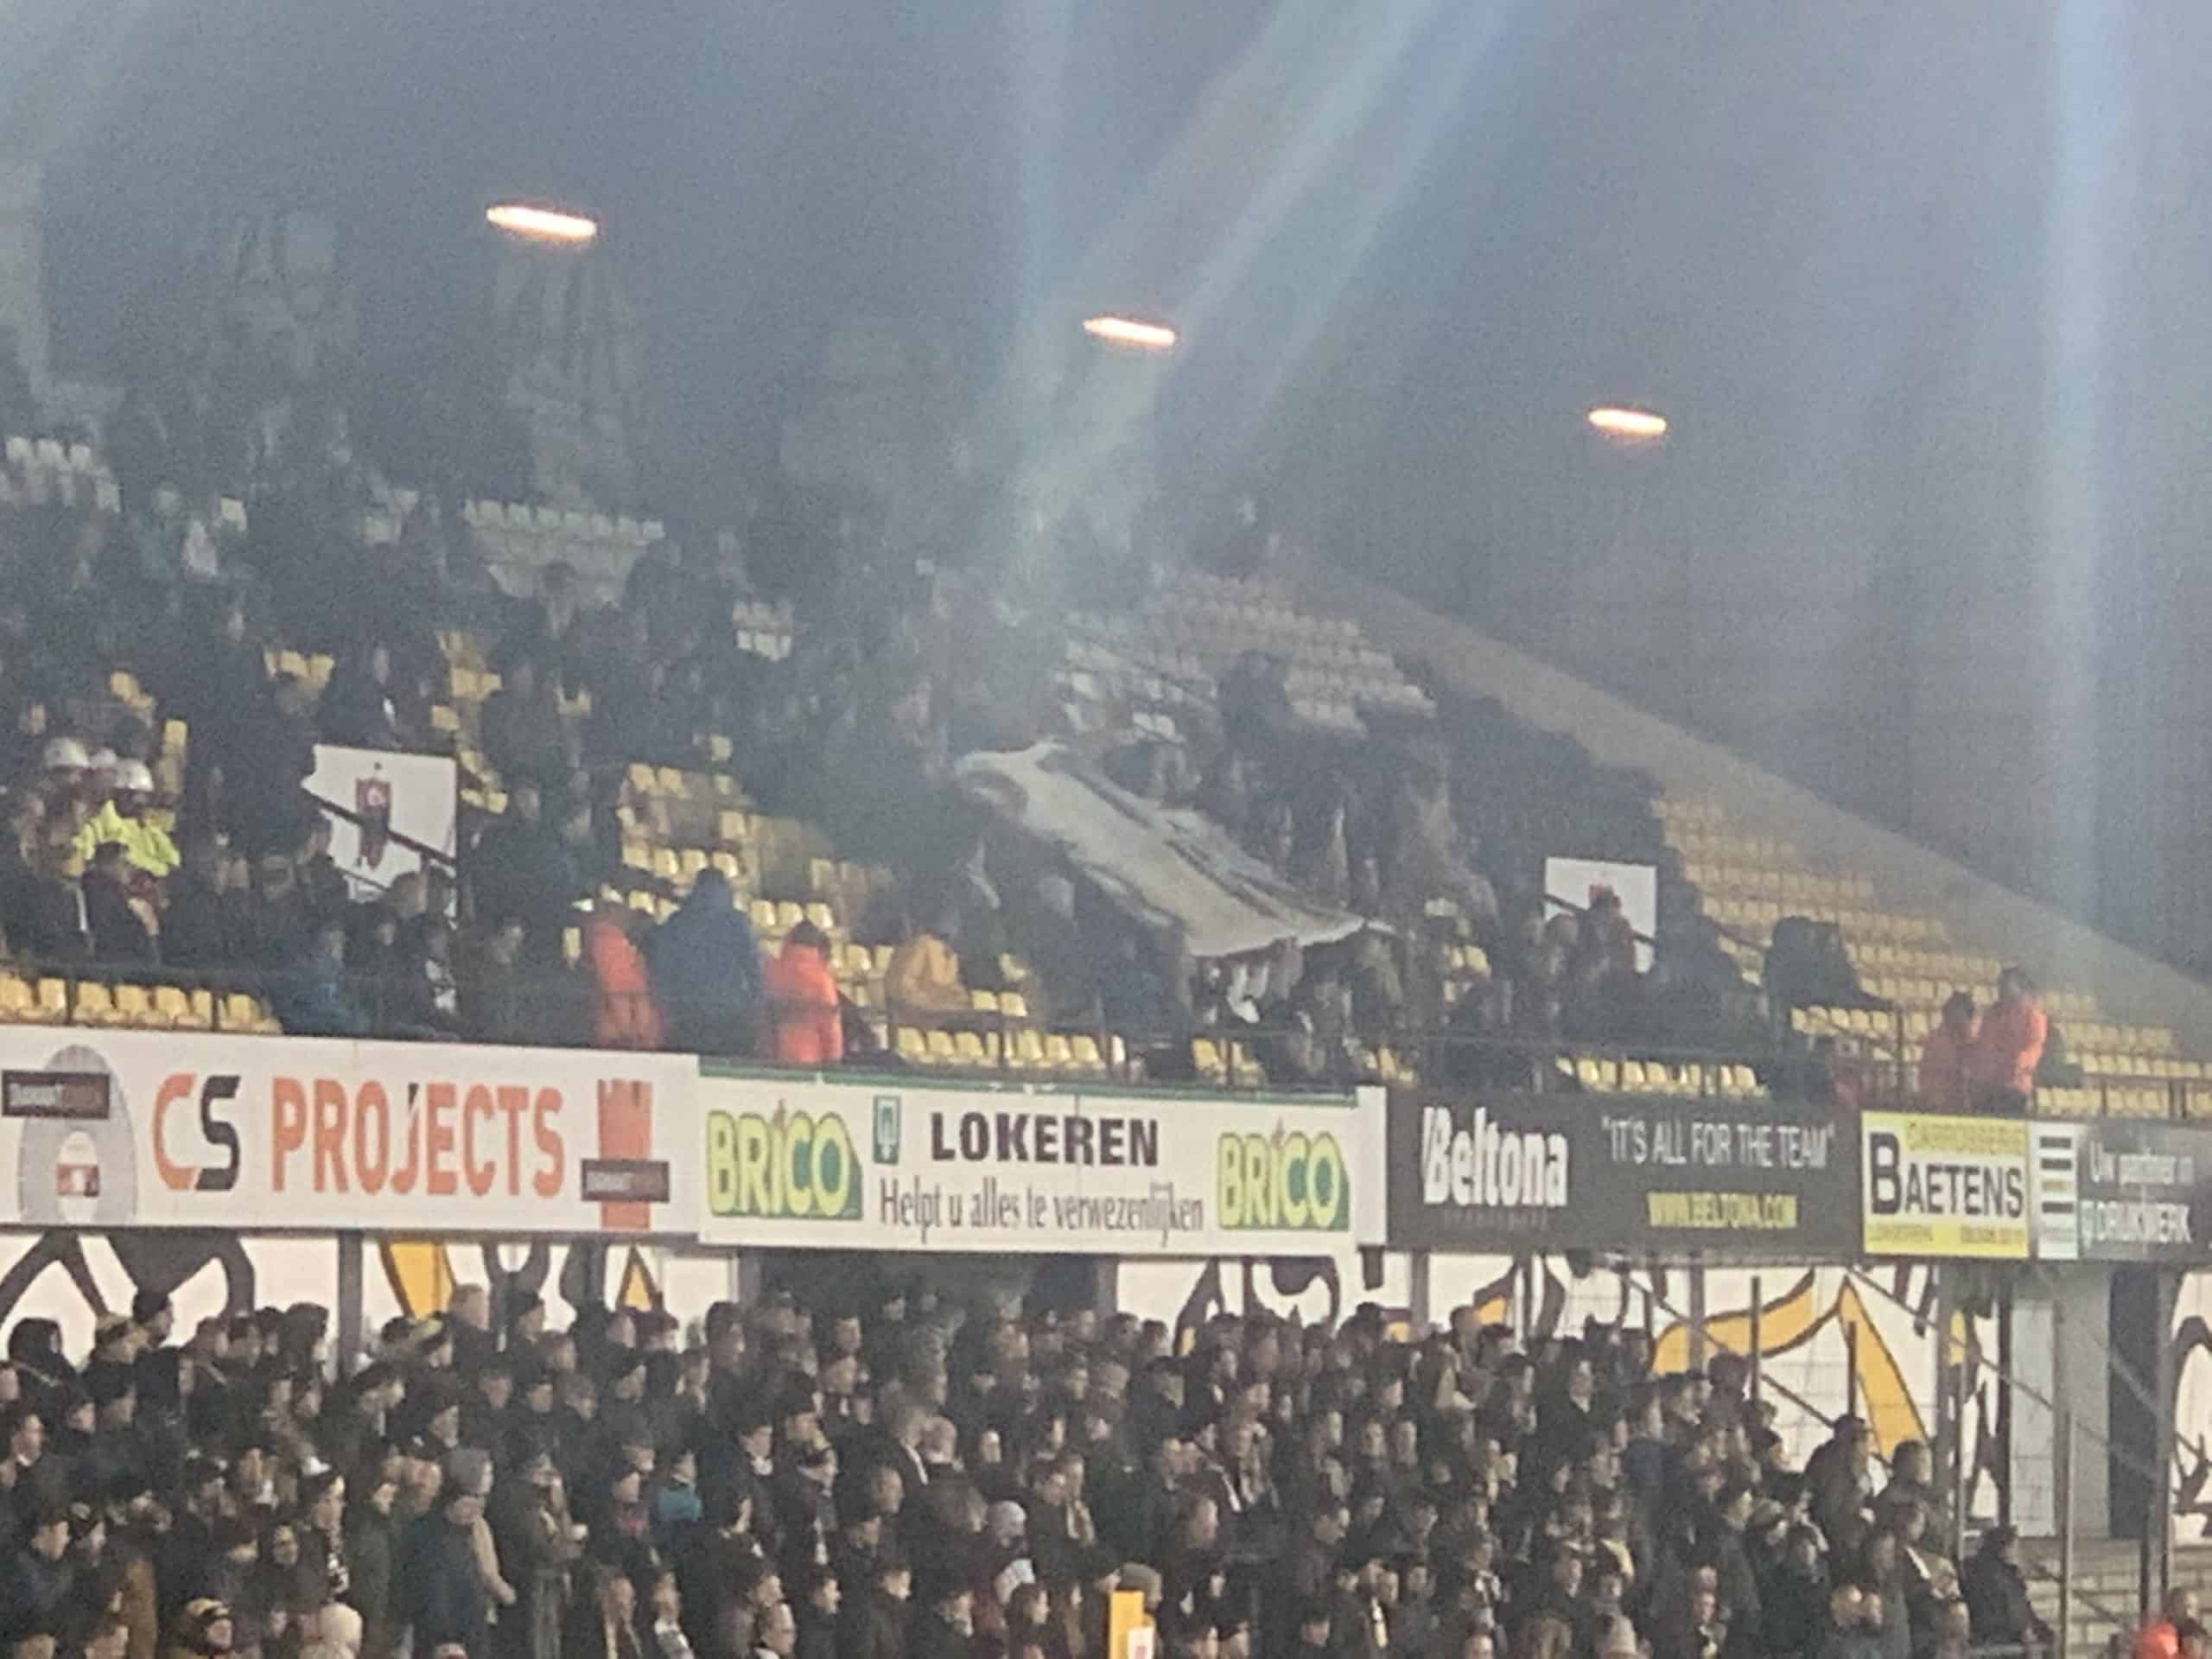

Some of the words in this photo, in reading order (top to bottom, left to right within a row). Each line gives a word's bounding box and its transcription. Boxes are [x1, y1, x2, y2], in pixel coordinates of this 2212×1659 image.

[151, 1074, 241, 1192] CS
[270, 1077, 566, 1198] PROJECTS
[706, 1103, 853, 1217] BRICO
[931, 1111, 1159, 1166] LOKEREN
[1218, 1119, 1343, 1230] BRICO
[1421, 1107, 1568, 1206] Beltona
[1651, 1122, 1688, 1165] ALL
[1692, 1122, 1732, 1165] FOR
[1737, 1124, 1772, 1167] THE
[1870, 1132, 2024, 1219] BAETENS
[880, 1175, 941, 1244] Helpt
[950, 1193, 963, 1227] u
[970, 1176, 1020, 1230] alles
[1027, 1186, 1047, 1229] te
